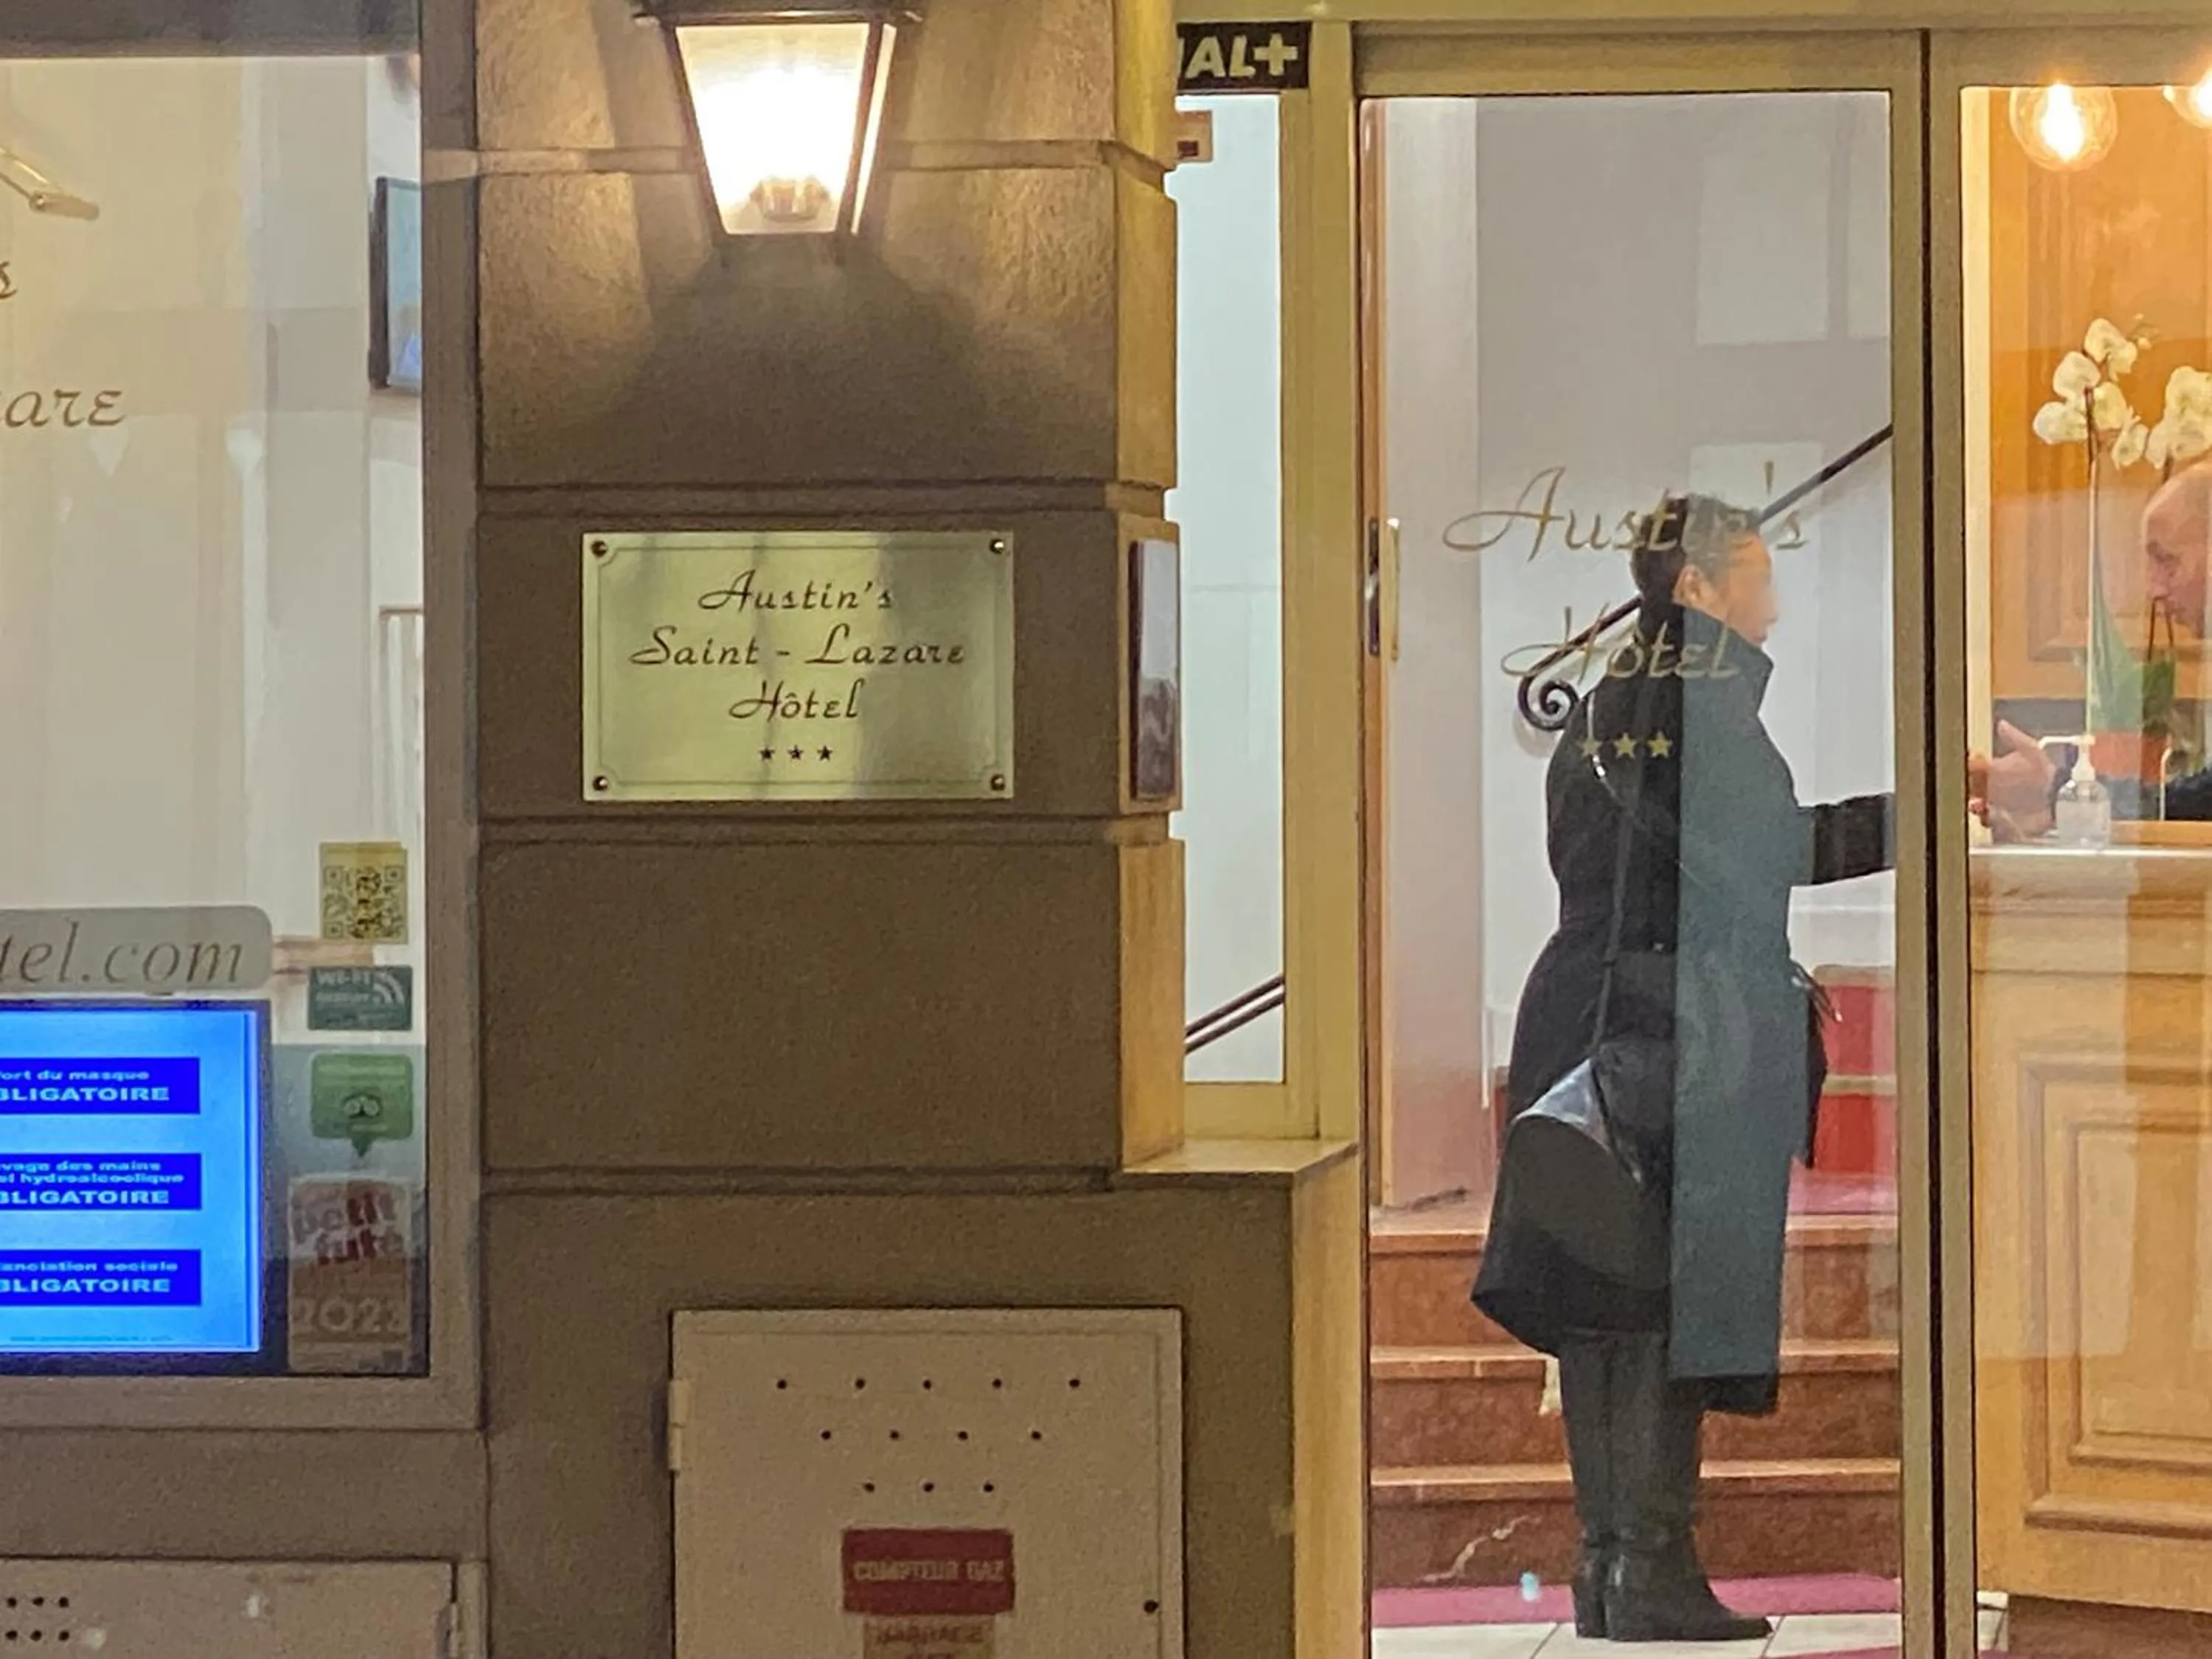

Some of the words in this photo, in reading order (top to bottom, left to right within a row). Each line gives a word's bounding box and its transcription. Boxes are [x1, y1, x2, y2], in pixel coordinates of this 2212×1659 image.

[1178, 32, 1298, 79] AL+
[0, 389, 127, 428] are
[1442, 460, 1809, 562] Austin's
[698, 569, 894, 613] Austin's
[628, 625, 759, 665] Saint
[804, 622, 965, 665] Lazare
[1500, 602, 1740, 684] Hôtel
[728, 678, 867, 722] Hôtel
[0, 1071, 32, 1081] ort
[37, 1069, 63, 1080] du
[69, 1071, 150, 1082] masque
[55, 1160, 94, 1172] des
[98, 1161, 162, 1172] mains
[104, 1259, 178, 1272] sociale
